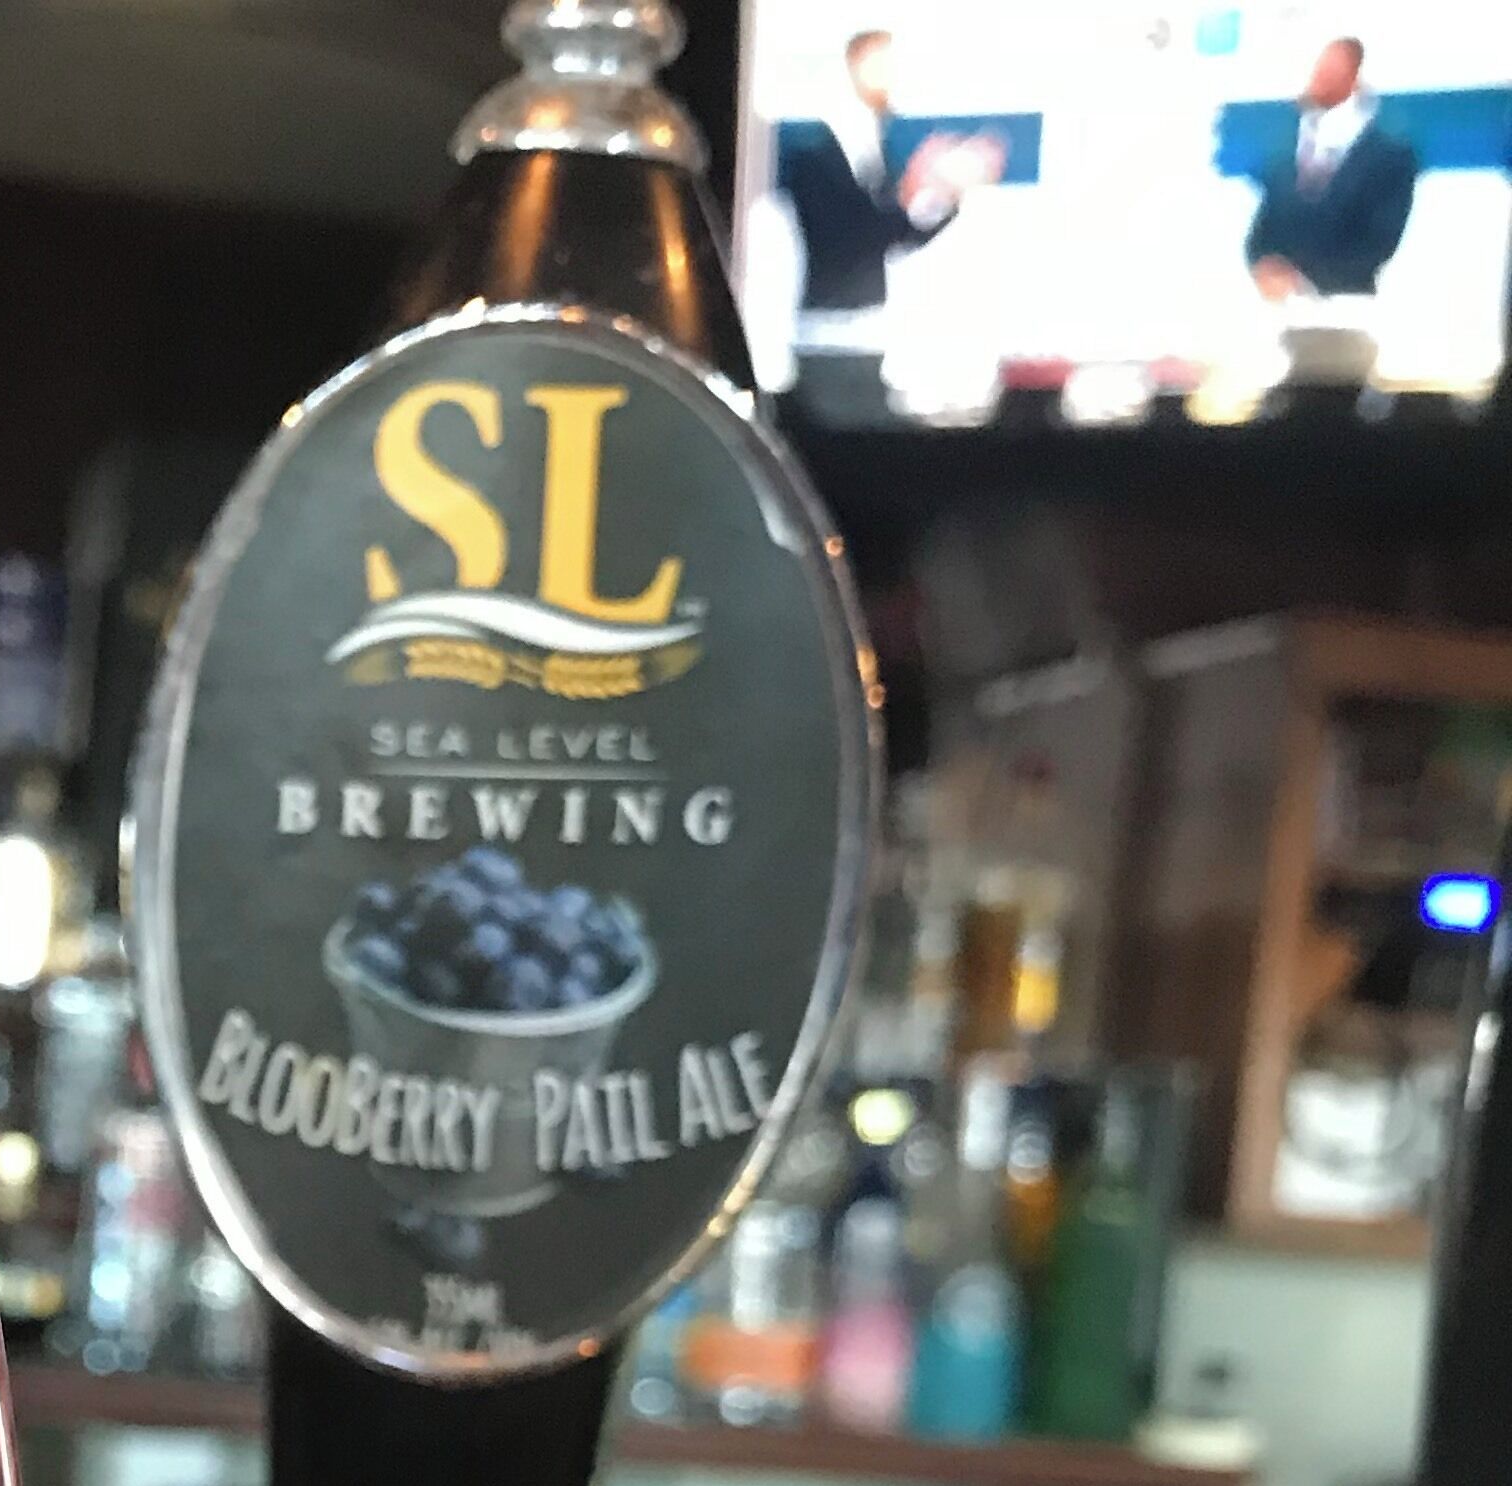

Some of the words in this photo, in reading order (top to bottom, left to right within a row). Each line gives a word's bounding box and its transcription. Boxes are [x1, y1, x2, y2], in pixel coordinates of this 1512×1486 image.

[365, 381, 684, 622] SL
[370, 723, 470, 758] SEA
[497, 724, 658, 763] LEVEL
[276, 778, 735, 846] BREWING
[200, 1008, 499, 1171] BLOOBERRY
[533, 1067, 671, 1172] PAIL
[678, 1030, 774, 1147] ALE
